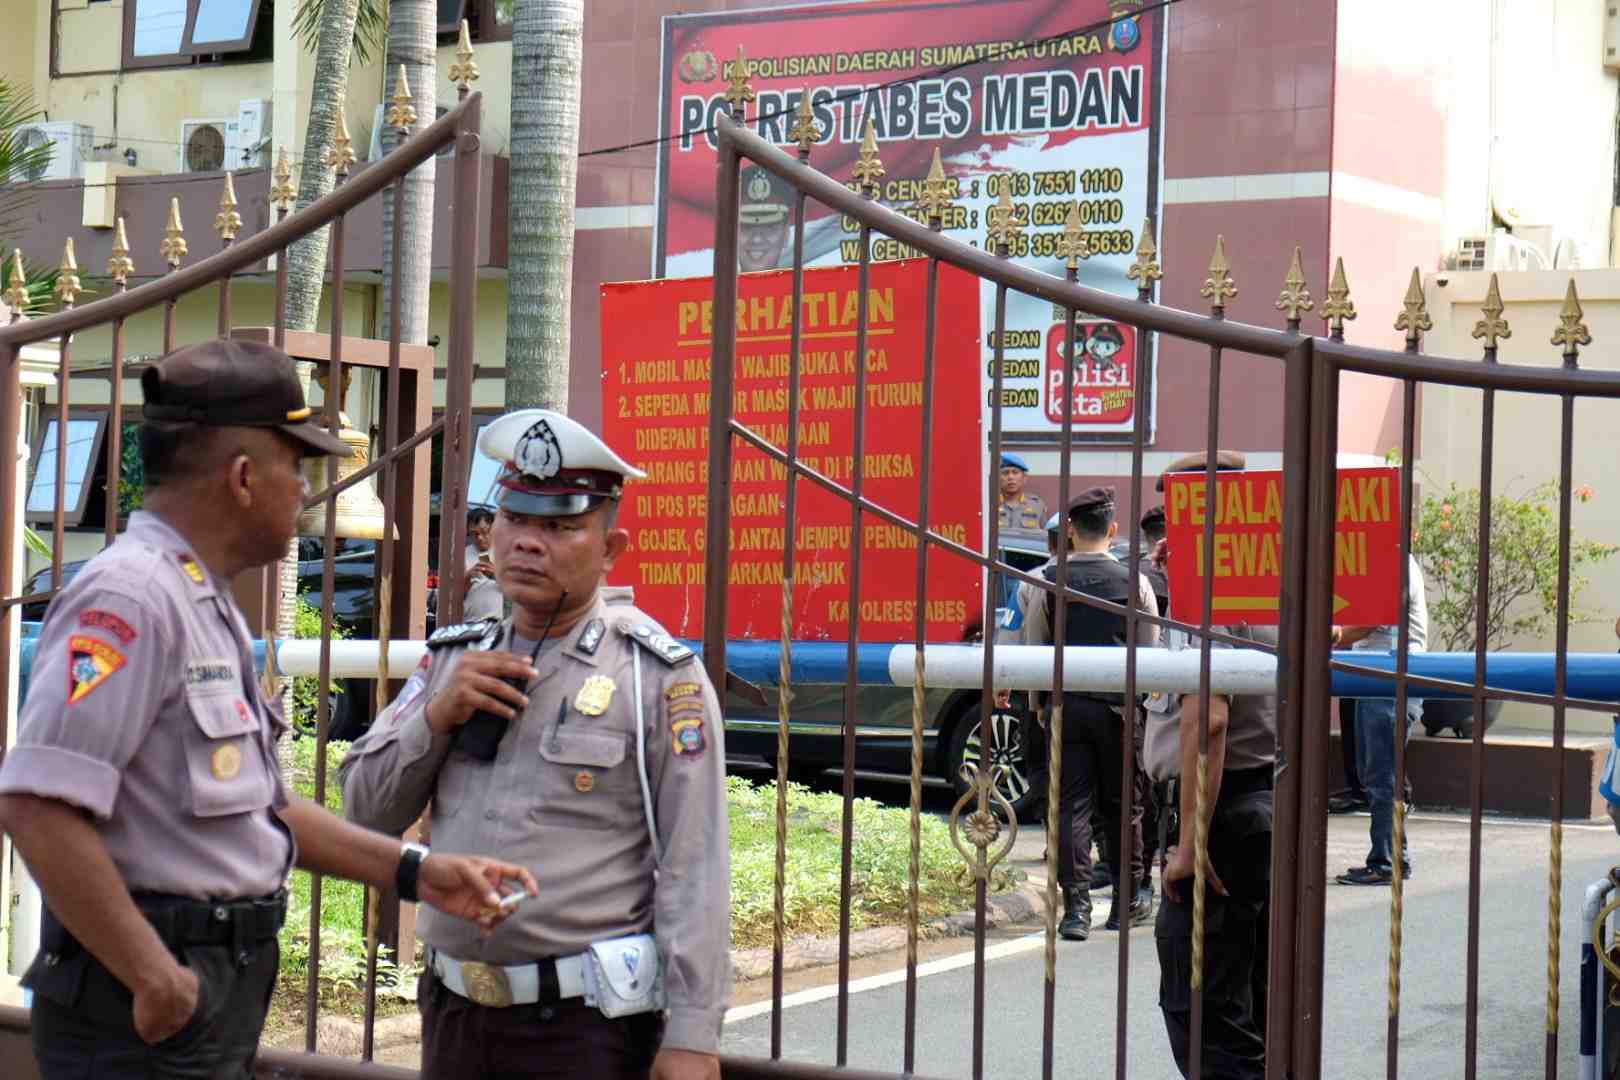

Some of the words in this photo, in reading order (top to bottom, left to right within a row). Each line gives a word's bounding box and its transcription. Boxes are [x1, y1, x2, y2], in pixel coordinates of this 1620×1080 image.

[836, 49, 915, 74] DAERAH
[920, 40, 1028, 67] SUMATERA
[1033, 34, 1102, 59] UTARA
[982, 64, 1144, 136] MEDAN
[1033, 170, 1076, 195] 7551
[1081, 167, 1123, 193] 1110
[1079, 198, 1123, 224] 0110
[618, 362, 631, 385] 1.
[635, 359, 680, 384] MOBIL
[741, 354, 790, 379] WAJIB
[844, 348, 888, 373] KCA
[618, 396, 631, 418] 2.
[635, 394, 689, 417] SEPEDA
[866, 383, 923, 407] TURUN
[1048, 389, 1103, 417] kta
[636, 427, 696, 450] DIDEPAN
[825, 455, 840, 479] DI
[846, 454, 914, 478] PRIKSA
[637, 496, 651, 517] DI
[656, 496, 684, 517] POS
[796, 527, 853, 550] JEMPU
[640, 563, 682, 584] TIDAK
